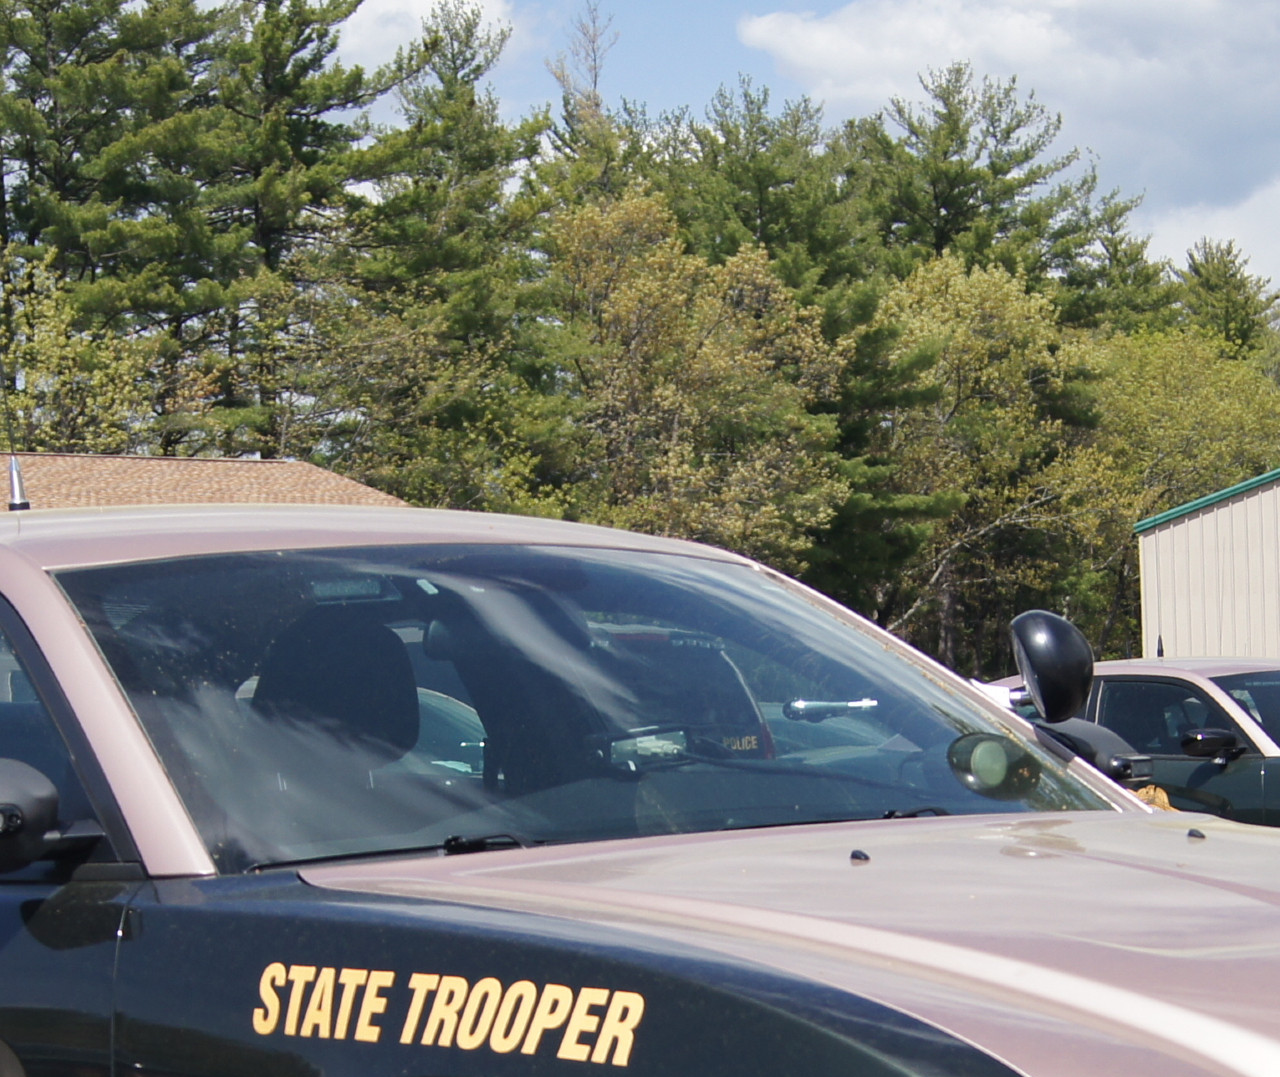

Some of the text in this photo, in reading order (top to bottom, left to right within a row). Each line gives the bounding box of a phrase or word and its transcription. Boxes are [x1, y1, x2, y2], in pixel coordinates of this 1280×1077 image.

[723, 736, 758, 750] POLICE
[252, 962, 646, 1068] STATE TROOPER
